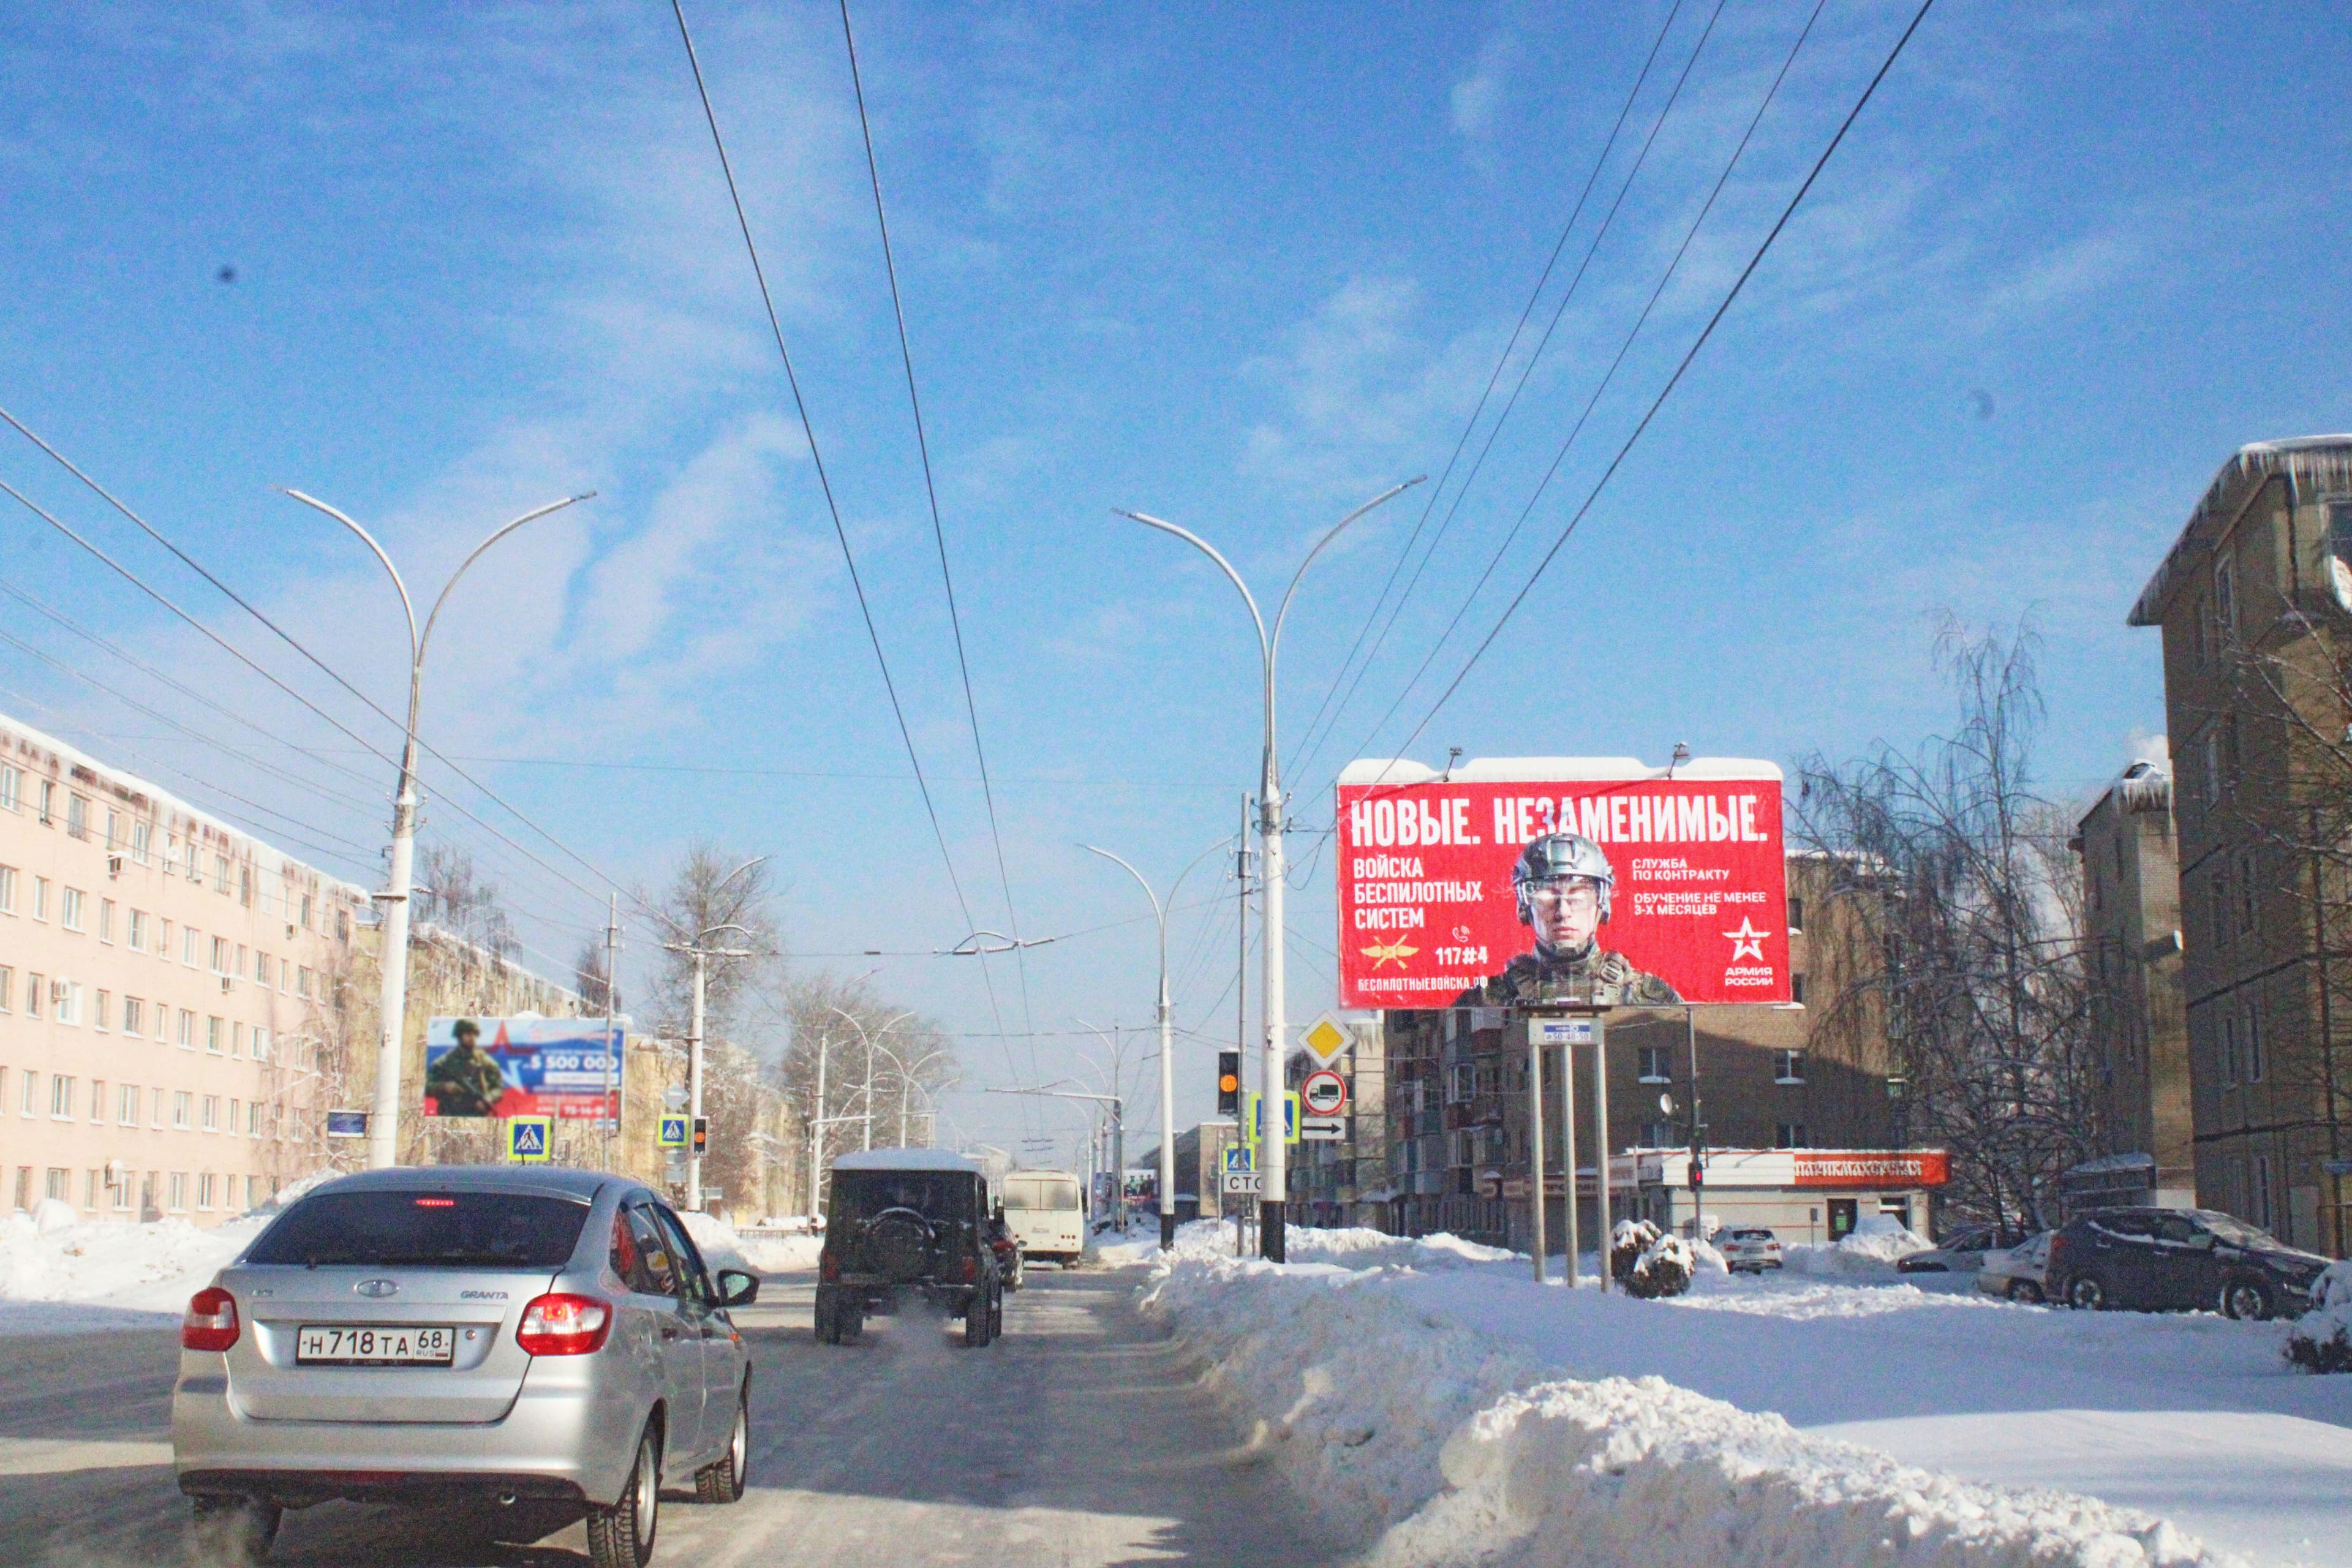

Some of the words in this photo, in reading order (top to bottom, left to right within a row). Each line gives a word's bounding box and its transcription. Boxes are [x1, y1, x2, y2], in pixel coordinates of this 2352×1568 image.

[1351, 798, 1481, 846] НОВЫЕ.
[1493, 795, 1768, 844] НЕЗАМЕНИМЫЕ.
[1353, 854, 1424, 879] ВОЙСКА
[1632, 858, 1687, 869] СЛУЖБА
[1632, 870, 1651, 880] ПО
[1654, 869, 1730, 881] КОНТРАКТУ
[1354, 881, 1483, 904] БЕСПИЛОТНЫХ
[1634, 892, 1701, 903] ОБУЧЕНИЕ
[1704, 892, 1721, 903] НЕ
[1724, 892, 1766, 903] МЕНЕЕ
[1634, 904, 1654, 915] 3-Х
[1657, 904, 1717, 916] МЕСЯЦЕВ
[1355, 907, 1425, 929] СИСТЕМ
[1435, 946, 1488, 966] 117#4
[1725, 967, 1773, 976] АРМИЯ
[1358, 976, 1488, 992] БЕСПИЛОТНЫЕВОЙСКА.РФ
[1725, 977, 1773, 986] РОССИИ
[545, 1055, 579, 1069] 500
[1795, 1160, 1922, 1177] ПАРИКМАХЕРСКАЯ
[460, 1290, 509, 1299] GRANTA
[418, 1330, 443, 1349] 68
